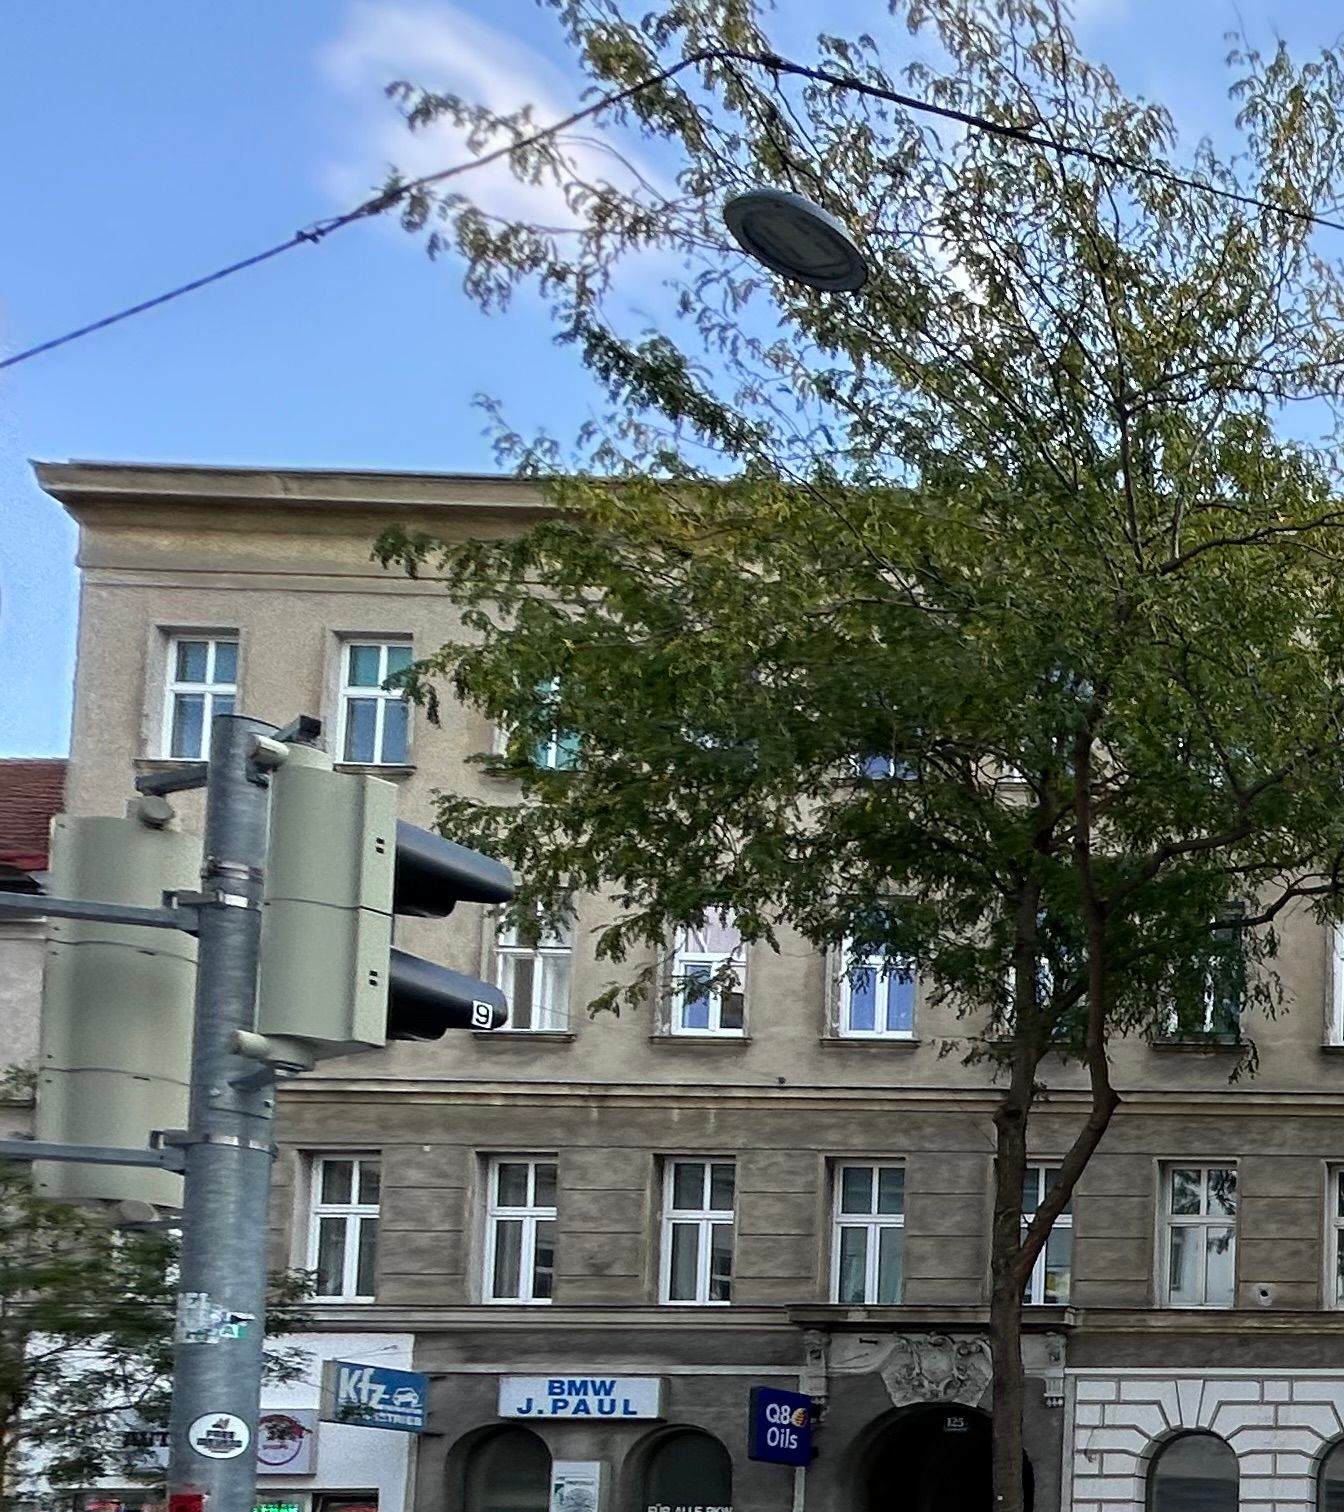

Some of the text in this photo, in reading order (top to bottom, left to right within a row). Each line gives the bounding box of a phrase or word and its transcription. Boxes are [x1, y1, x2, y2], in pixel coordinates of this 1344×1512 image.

[475, 1004, 490, 1025] 9
[547, 1379, 617, 1396] BMW
[765, 1403, 791, 1425] Q8
[766, 1426, 798, 1449] Oils
